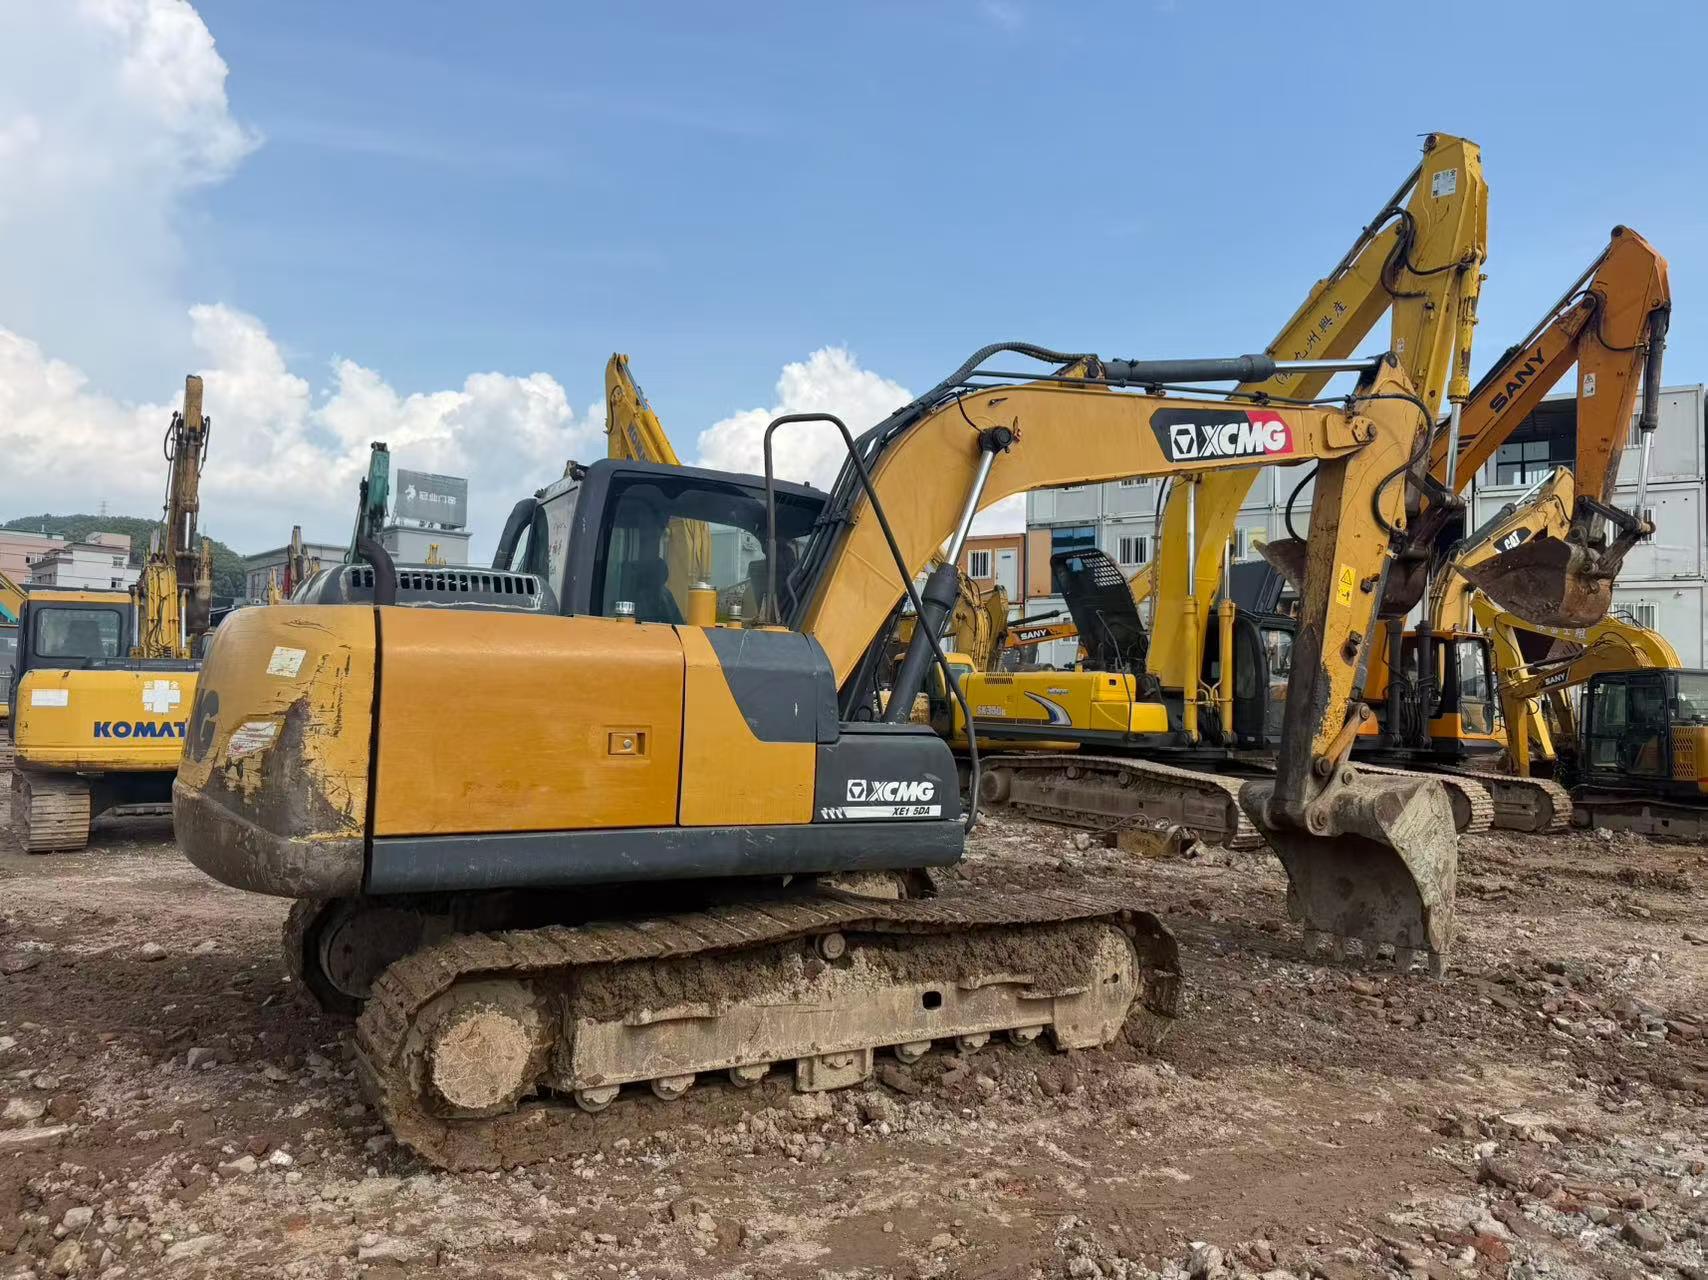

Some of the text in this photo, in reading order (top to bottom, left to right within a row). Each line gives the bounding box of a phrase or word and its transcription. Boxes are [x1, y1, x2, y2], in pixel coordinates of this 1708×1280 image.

[1490, 347, 1544, 413] SANY
[1199, 421, 1286, 457] XCMG
[1504, 530, 1521, 550] CAT
[1020, 628, 1047, 641] SANY
[1545, 672, 1566, 685] SANY
[94, 721, 186, 738] KOMAT
[866, 781, 935, 801] XCMG
